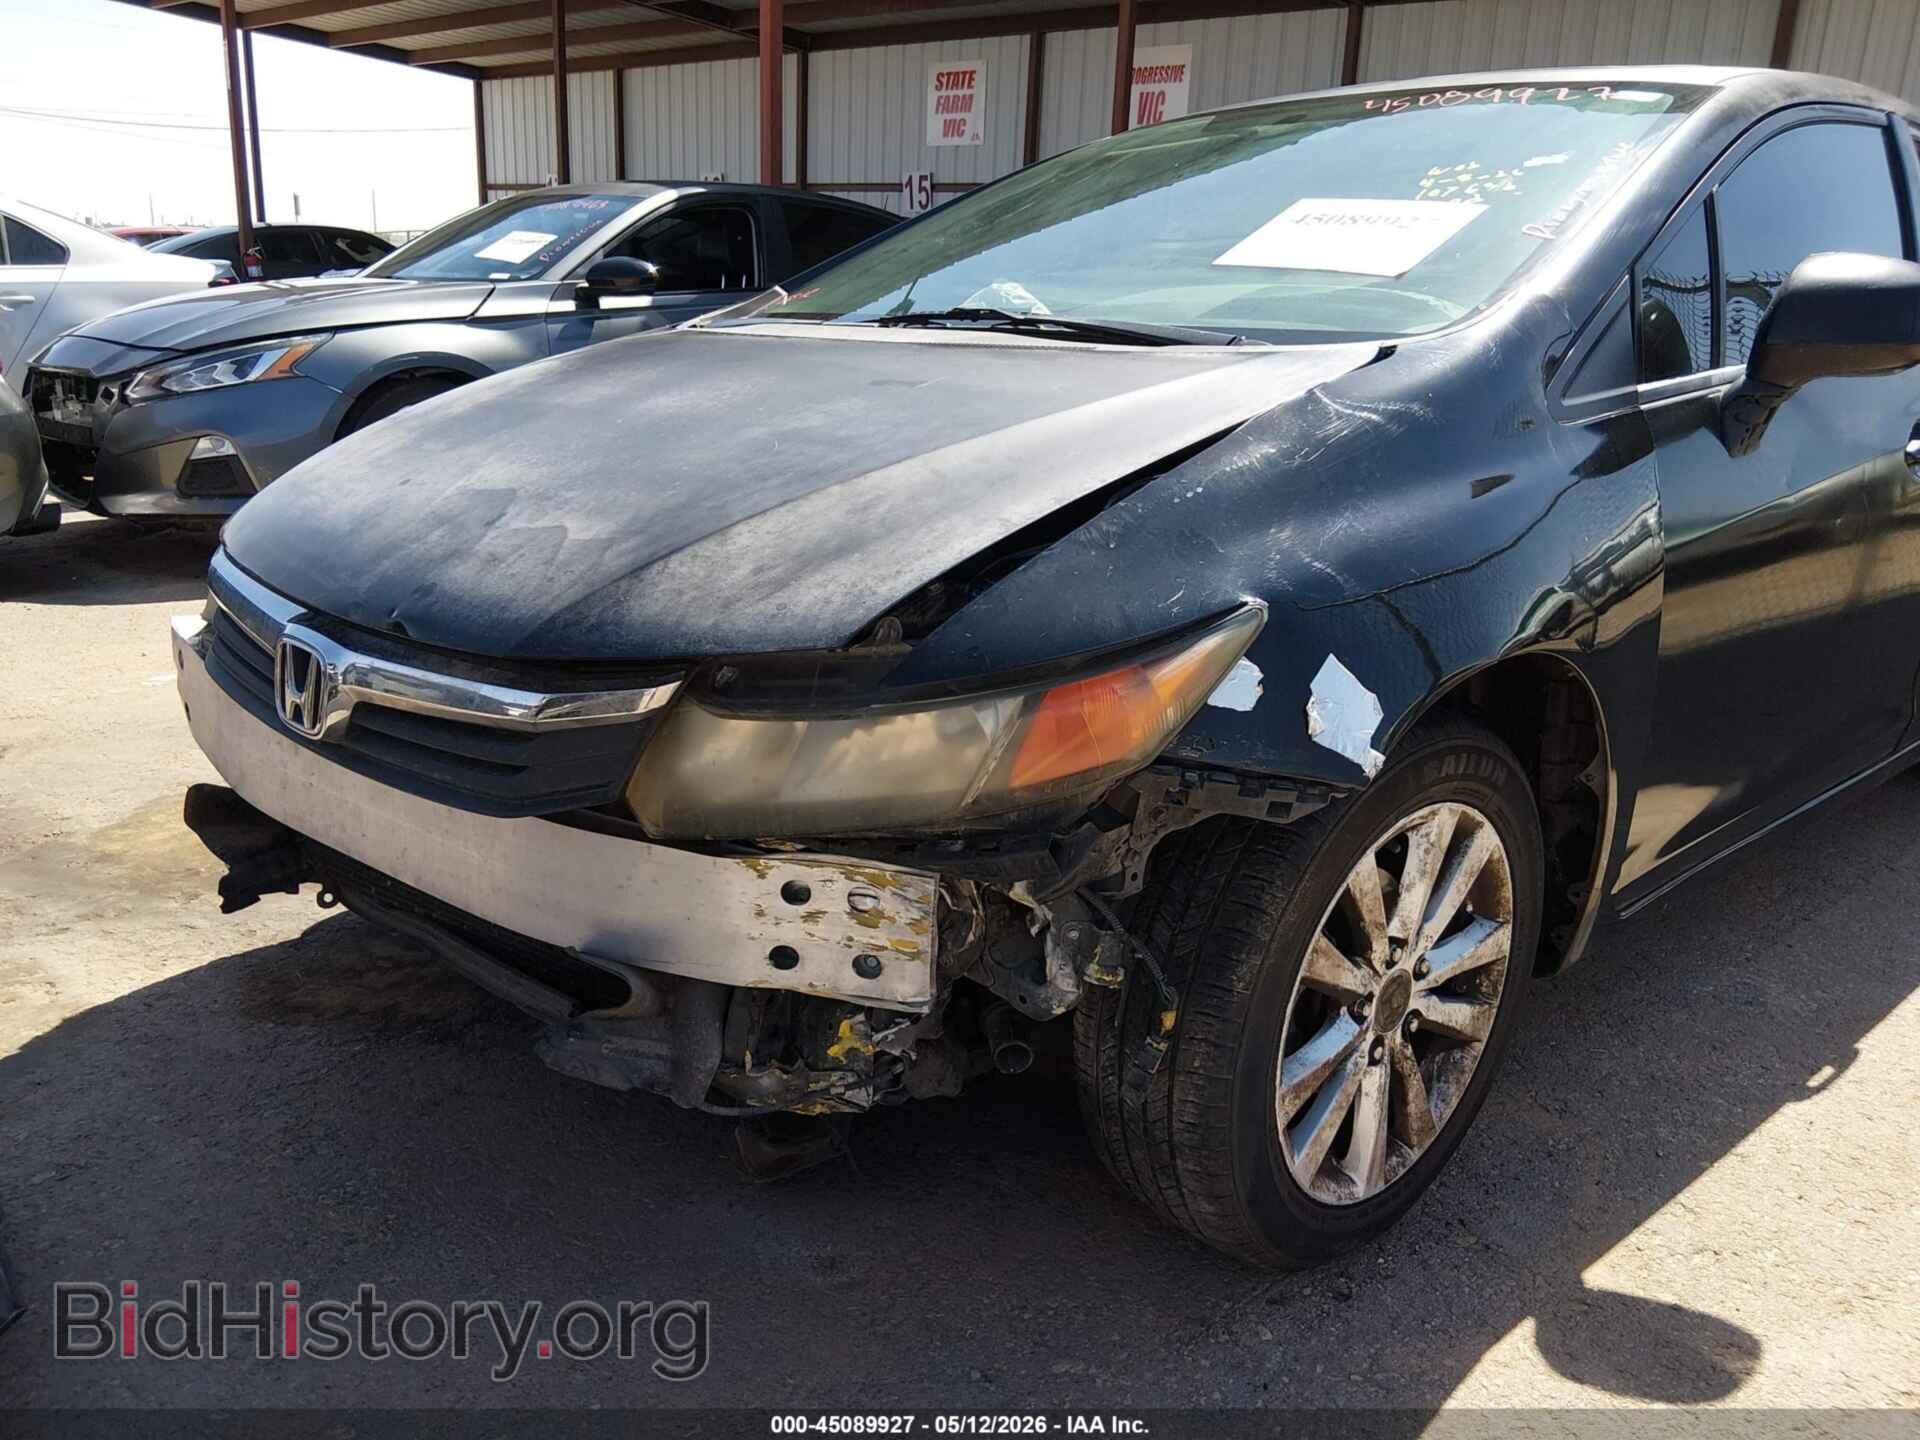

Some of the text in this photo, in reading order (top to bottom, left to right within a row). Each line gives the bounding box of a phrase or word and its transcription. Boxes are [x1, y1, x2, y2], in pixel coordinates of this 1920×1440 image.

[935, 70, 977, 92] STATE
[1132, 64, 1185, 84] OGRESSIVE
[935, 94, 975, 115] FARM
[1137, 89, 1166, 126] VIC
[942, 117, 967, 139] VIC
[905, 174, 930, 210] 15
